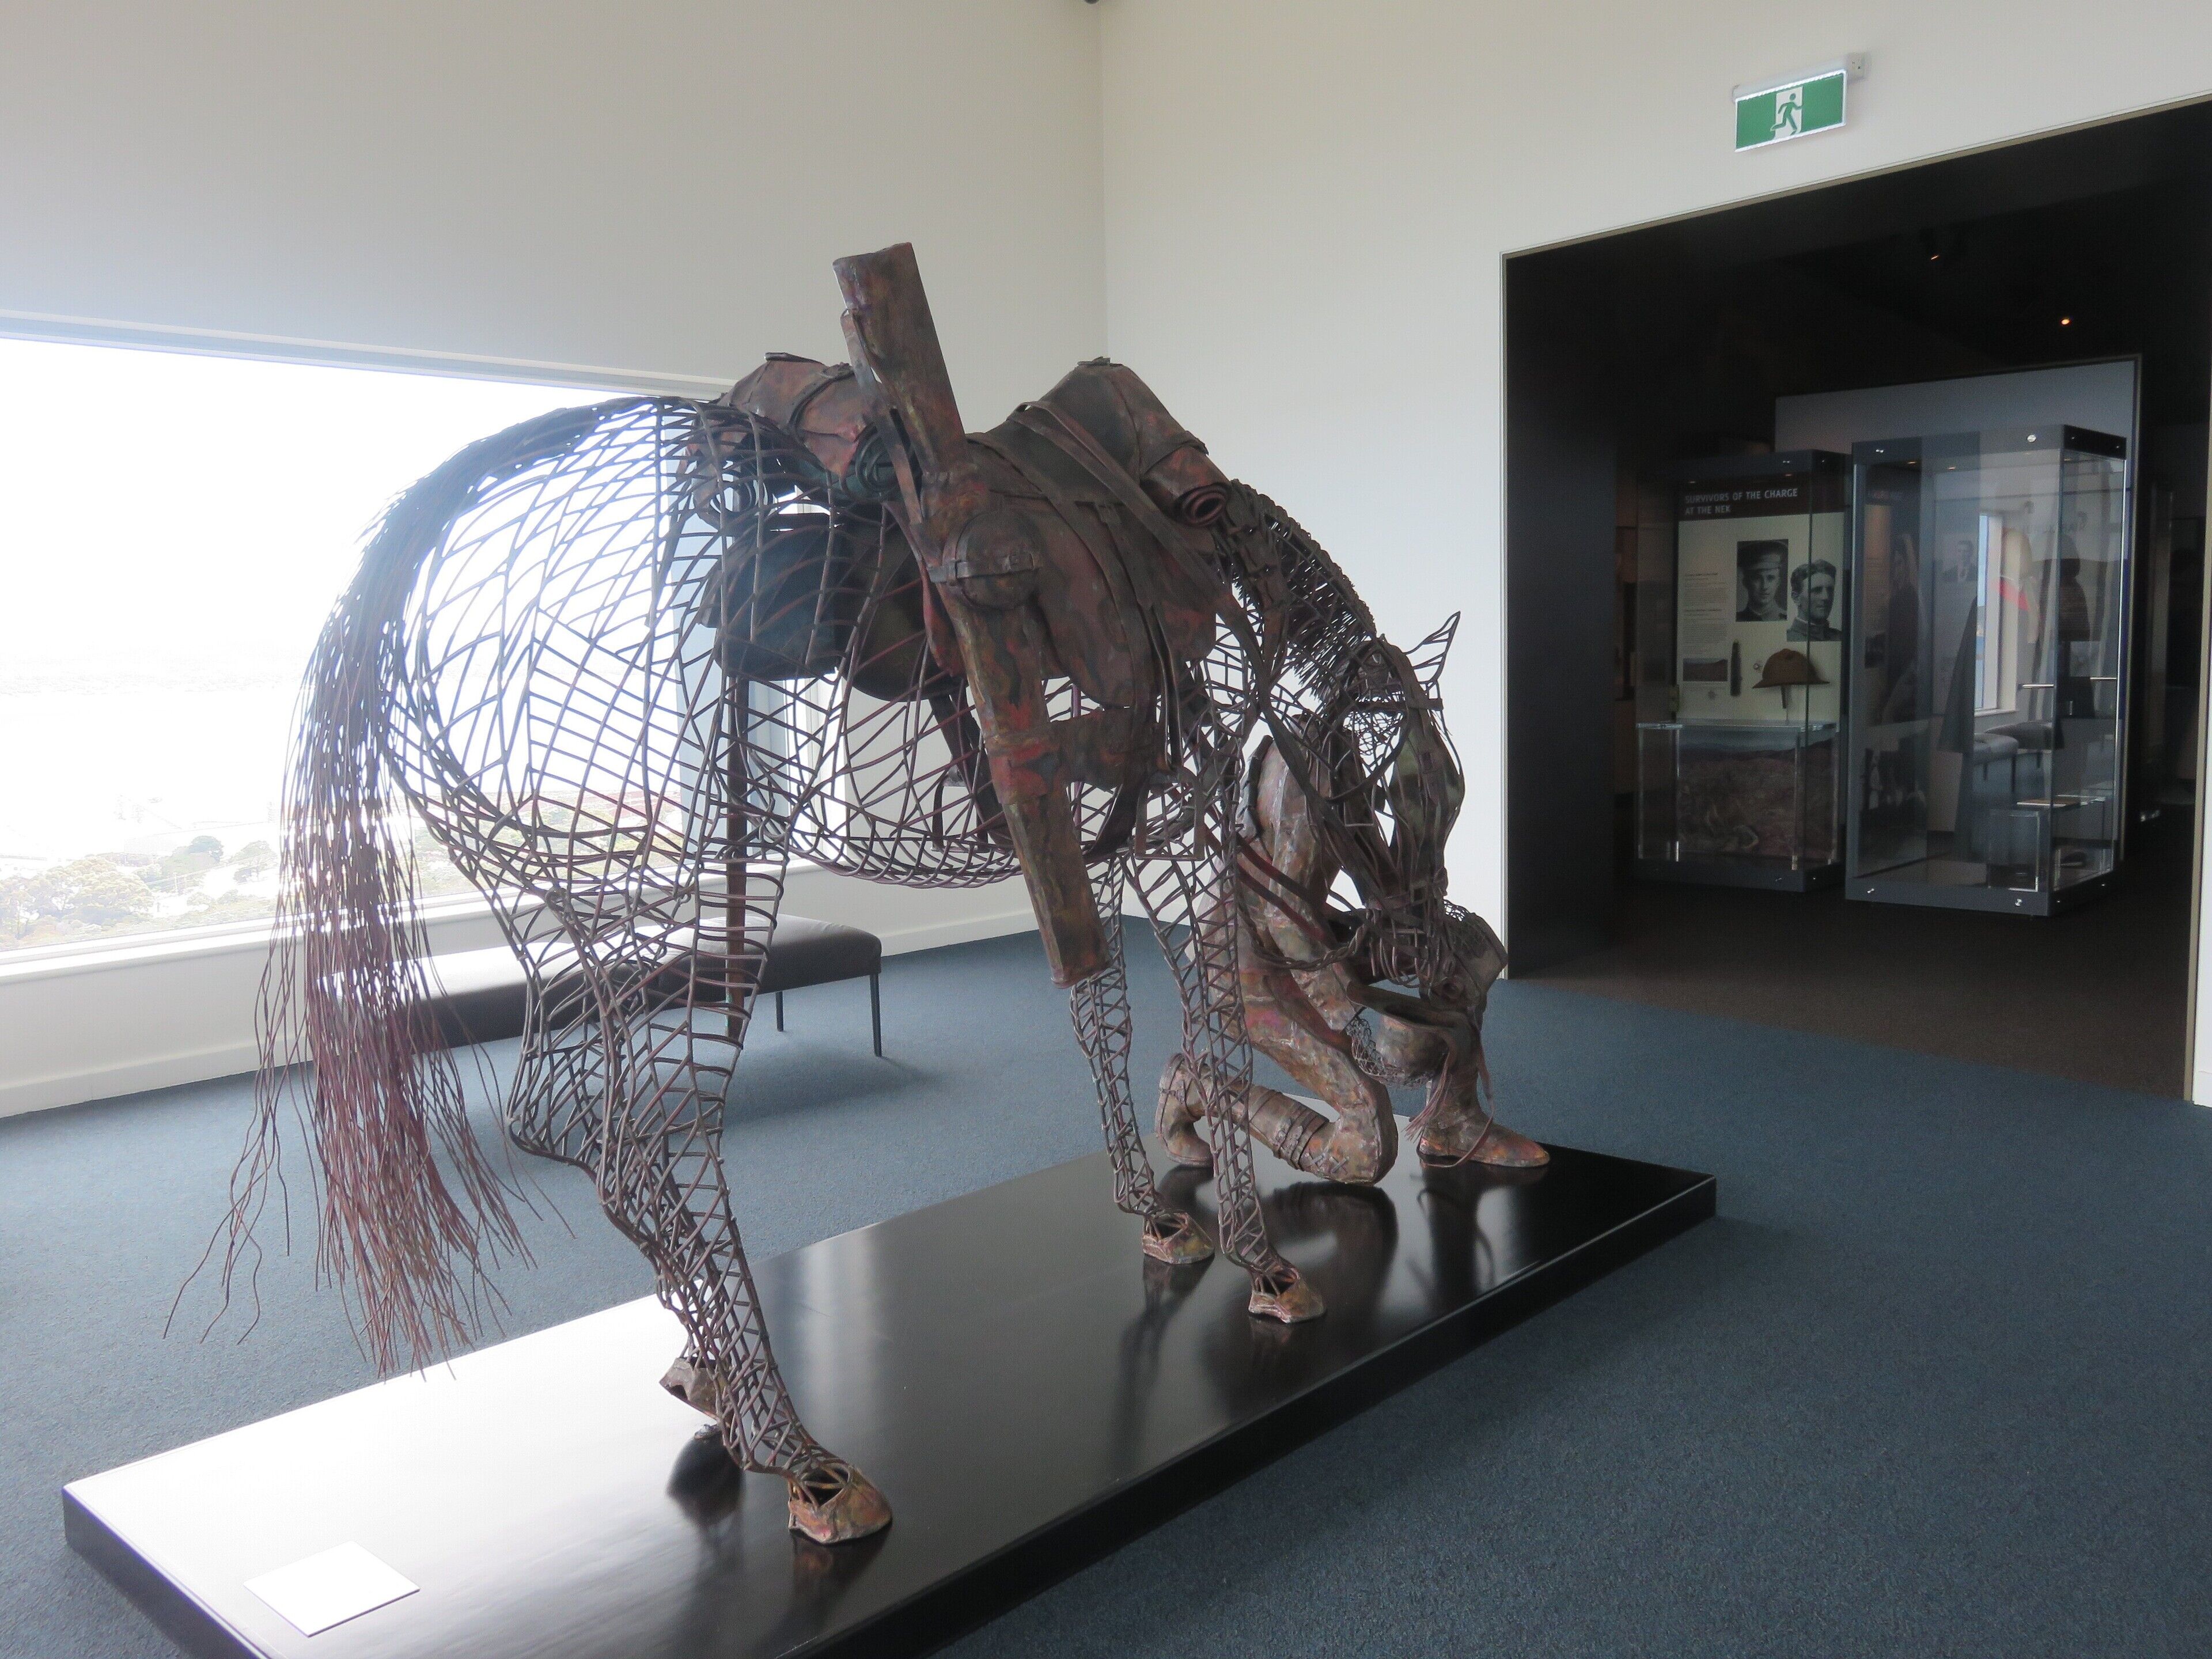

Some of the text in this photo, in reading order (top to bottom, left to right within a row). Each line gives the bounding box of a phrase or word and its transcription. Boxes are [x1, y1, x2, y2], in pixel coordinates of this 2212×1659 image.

[1733, 492, 1743, 501] OF
[1746, 490, 1760, 499] THE
[1764, 488, 1798, 498] CHARGE
[1685, 506, 1694, 515] AT
[1698, 505, 1712, 514] THE
